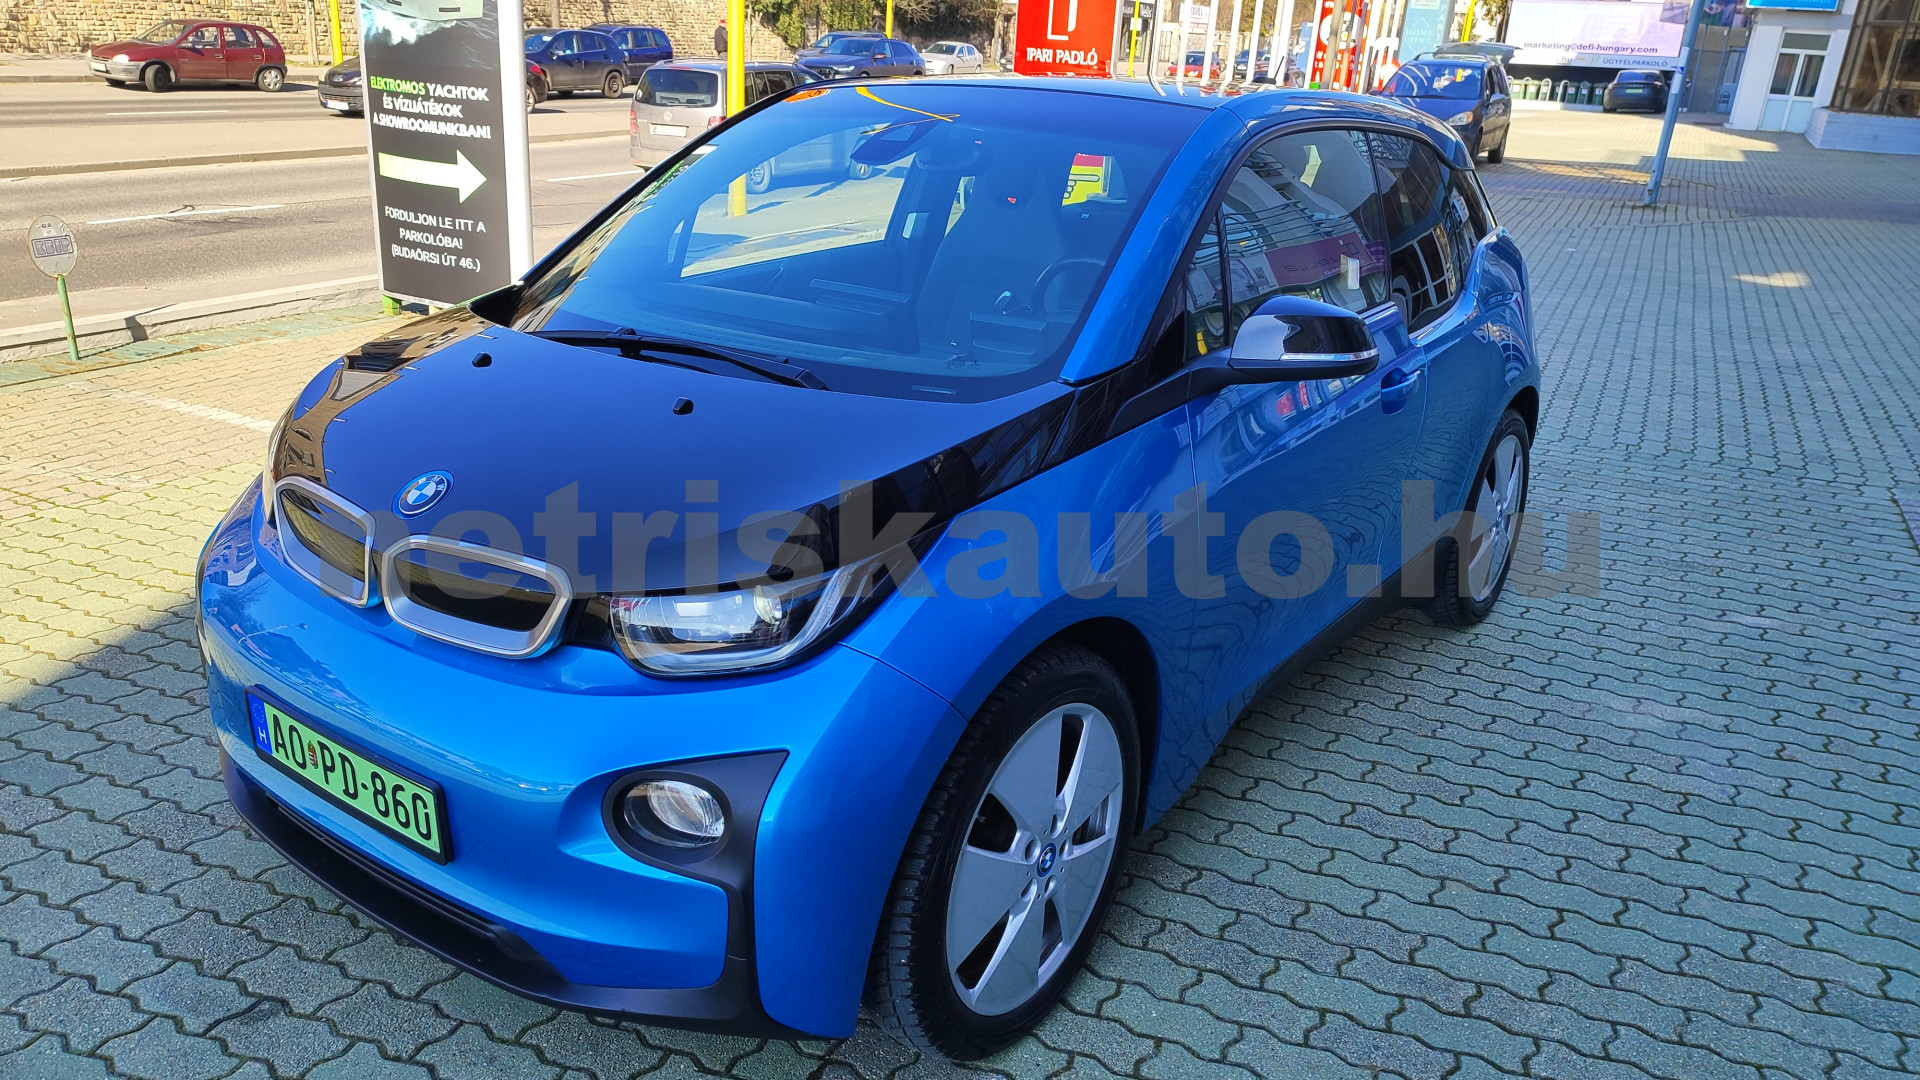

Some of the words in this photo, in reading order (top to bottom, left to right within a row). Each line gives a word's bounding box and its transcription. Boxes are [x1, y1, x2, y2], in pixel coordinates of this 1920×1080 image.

[1026, 47, 1053, 63] IPARI
[1056, 47, 1098, 66] PADLÓ
[1524, 41, 1658, 54] marketing@defi-hungary.com
[1603, 57, 1668, 67] ÜGYFÉLPARKOLÓ
[370, 76, 426, 95] ELEKTROMOS
[427, 83, 489, 102] YACHTOK
[383, 93, 395, 109] ÉS
[373, 112, 379, 125] A
[379, 113, 491, 139] SHOWROOMUNKBAN!
[385, 206, 437, 227] FORDULJON
[439, 216, 453, 230] LE
[455, 218, 474, 232] ITT
[476, 222, 486, 233] A
[399, 228, 463, 250] PARKOLÓBA!
[442, 252, 457, 267] ÚT
[459, 257, 481, 272] 46.)
[258, 726, 267, 745] H
